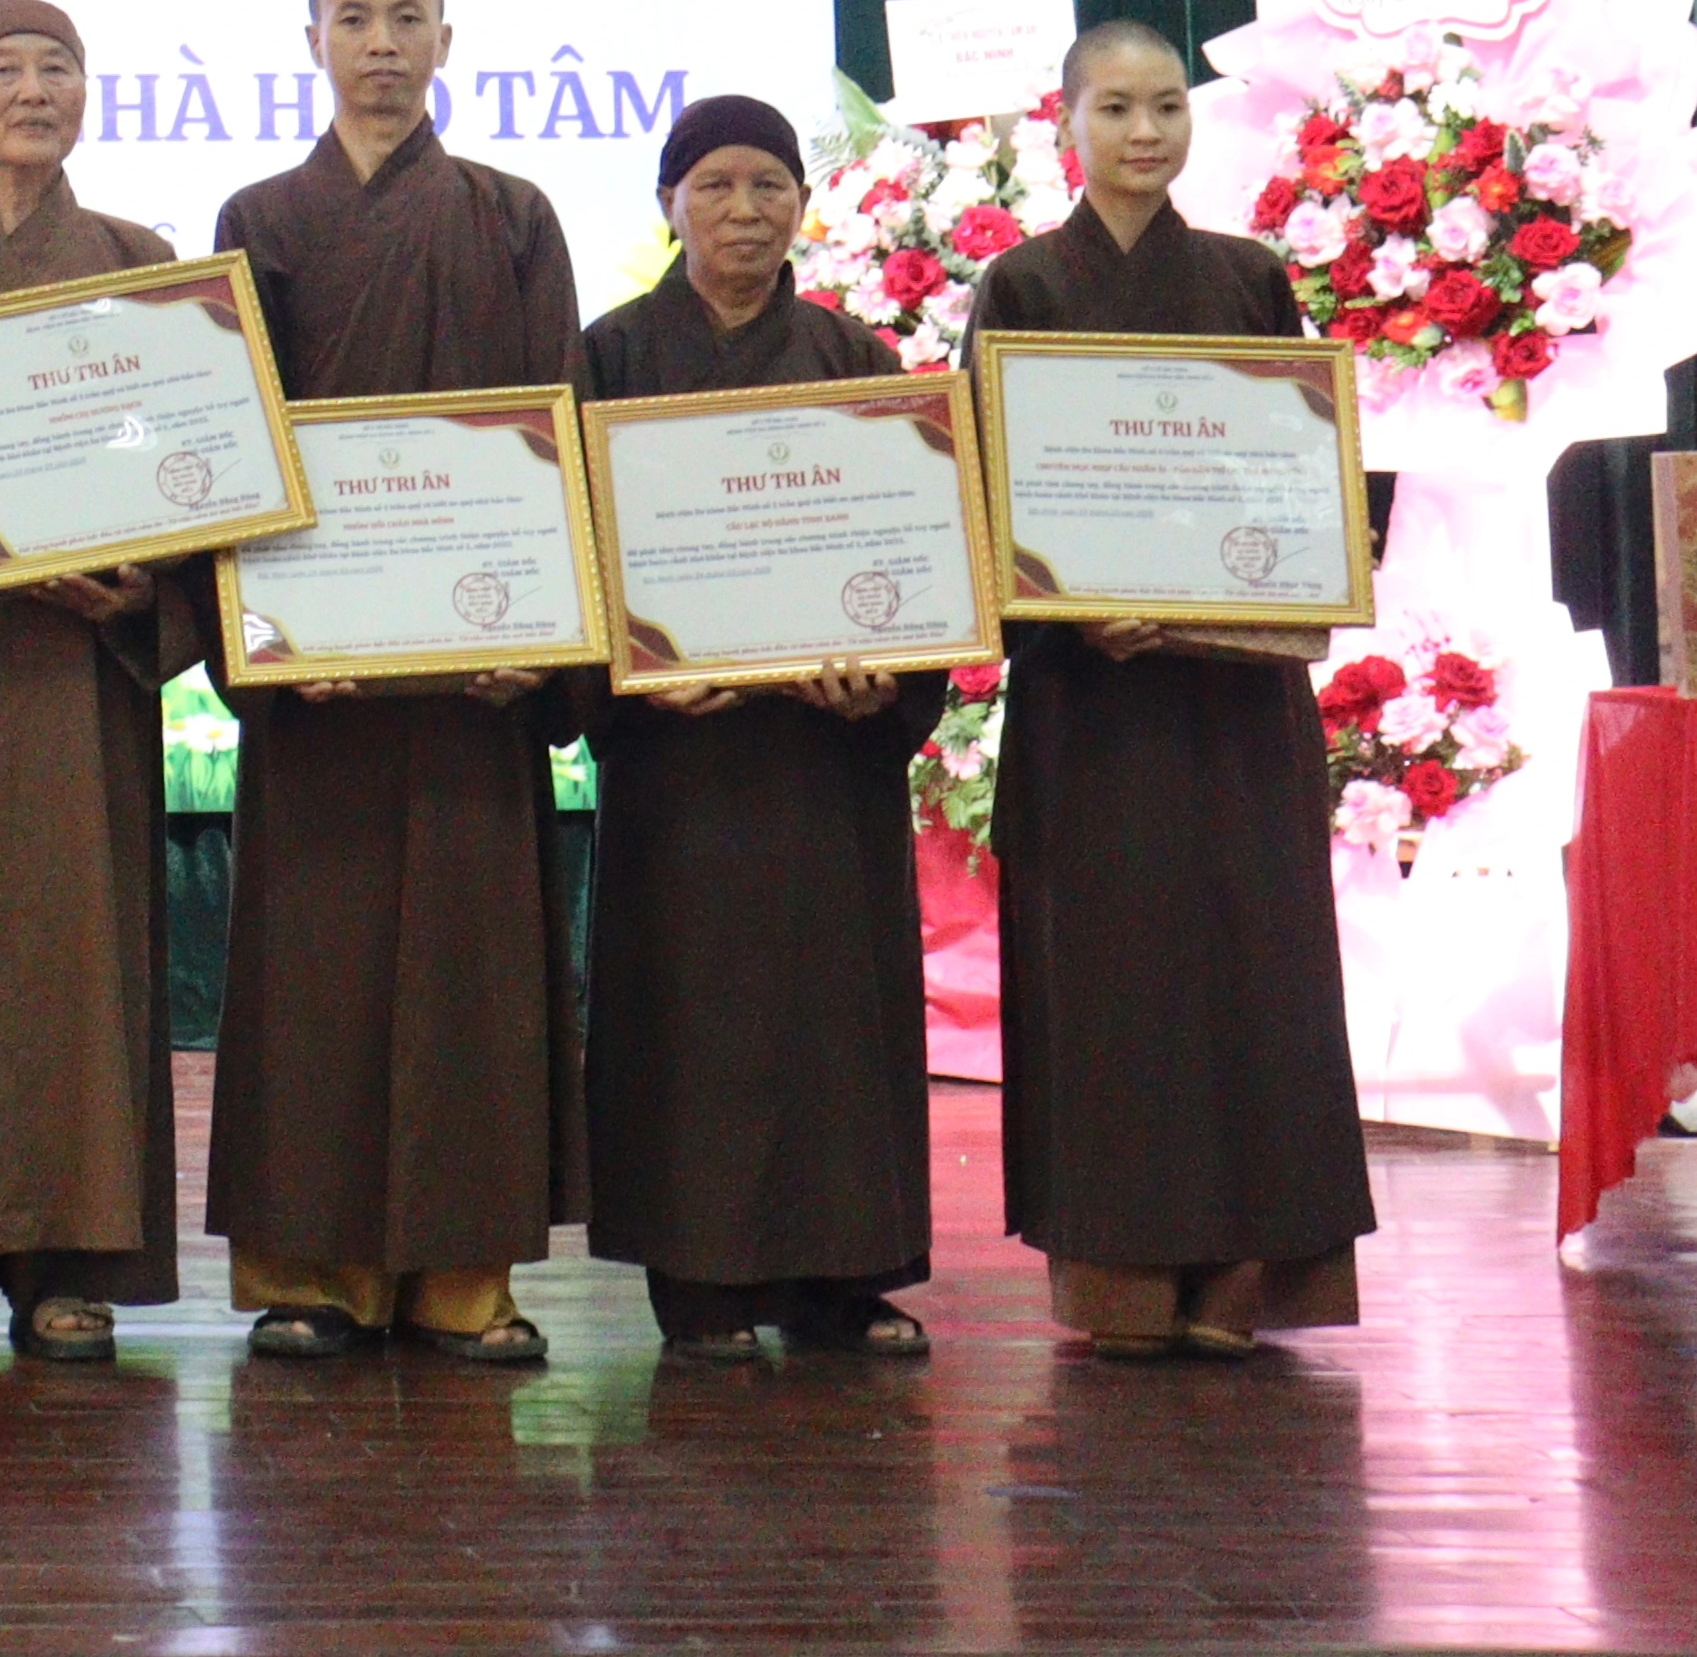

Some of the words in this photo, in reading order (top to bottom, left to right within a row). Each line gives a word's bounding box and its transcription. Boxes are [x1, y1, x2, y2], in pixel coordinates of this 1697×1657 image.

[75, 44, 233, 143] HÀ
[475, 44, 690, 140] TÂM
[27, 367, 71, 391] THƯ
[74, 361, 109, 382] TRI
[112, 353, 141, 375] ÂN
[1109, 418, 1155, 437] THƯ
[1157, 419, 1192, 438] TRI
[1197, 415, 1227, 440] ÂN
[334, 476, 378, 496] THƯ
[382, 475, 417, 493] TRI
[420, 470, 451, 491] ÂN
[721, 472, 767, 495] THƯ
[770, 470, 807, 490] TRI
[811, 463, 842, 487] ÂN
